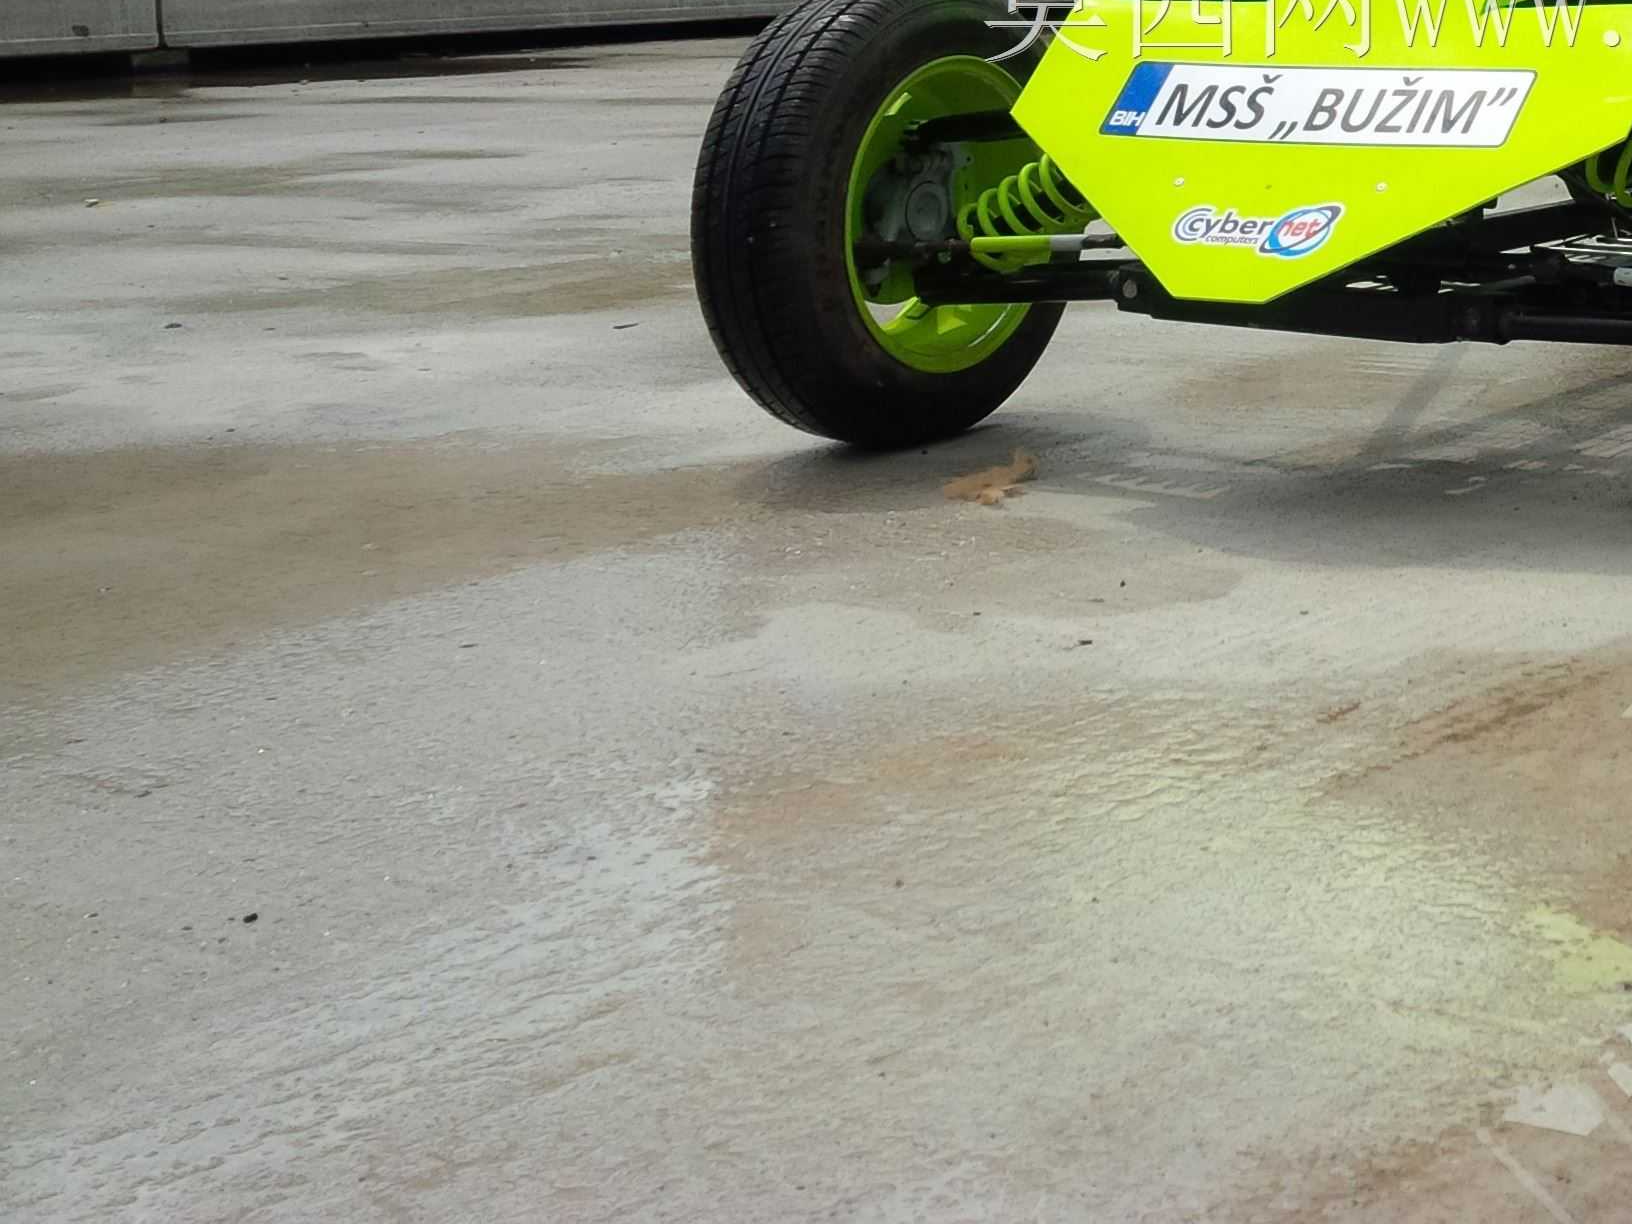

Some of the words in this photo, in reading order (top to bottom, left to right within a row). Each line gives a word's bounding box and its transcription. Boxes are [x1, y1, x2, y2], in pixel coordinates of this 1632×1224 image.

[1155, 74, 1283, 129] MSŠ
[1109, 110, 1146, 127] BIH
[1205, 234, 1258, 245] computers
